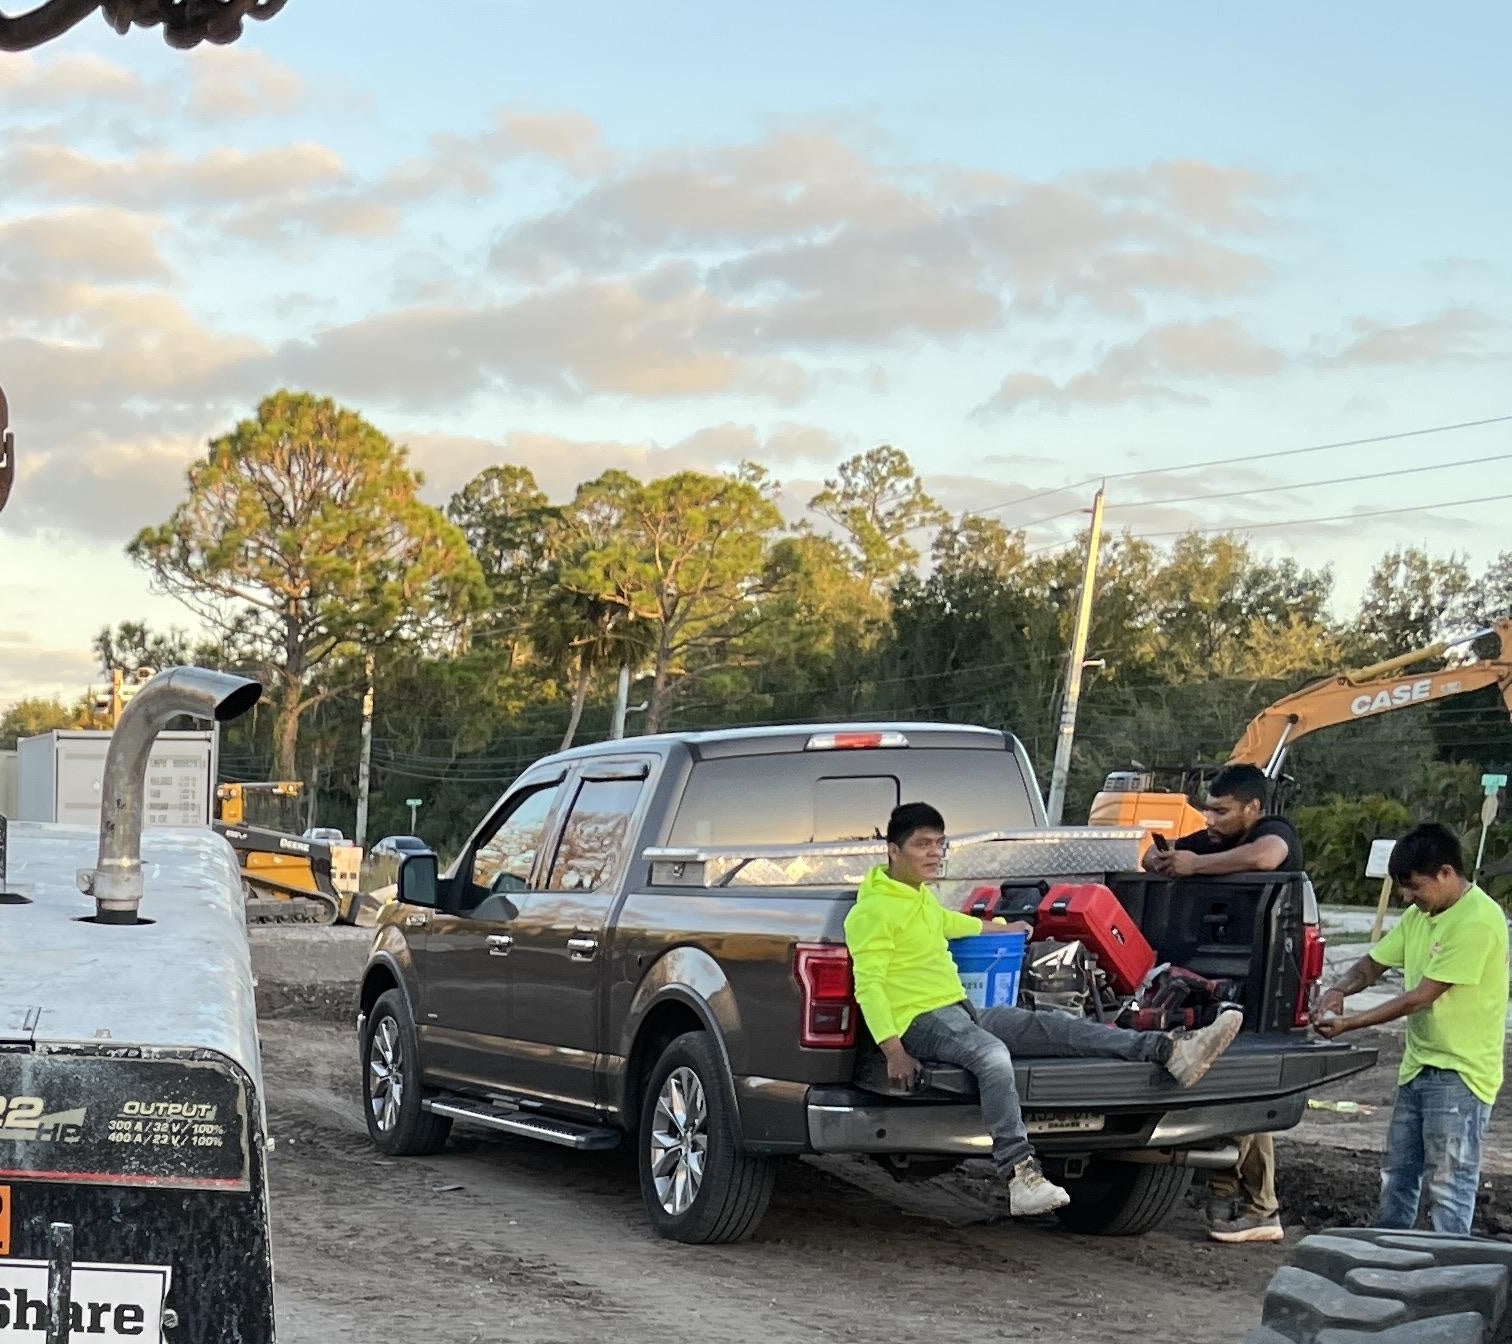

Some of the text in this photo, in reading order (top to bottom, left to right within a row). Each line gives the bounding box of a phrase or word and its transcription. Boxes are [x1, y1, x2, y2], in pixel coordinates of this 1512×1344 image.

[1351, 679, 1432, 715] CASE
[122, 1101, 212, 1118] OUTPUT
[108, 1120, 132, 1131] 300
[152, 1122, 170, 1133] 32
[107, 1132, 132, 1143] 400
